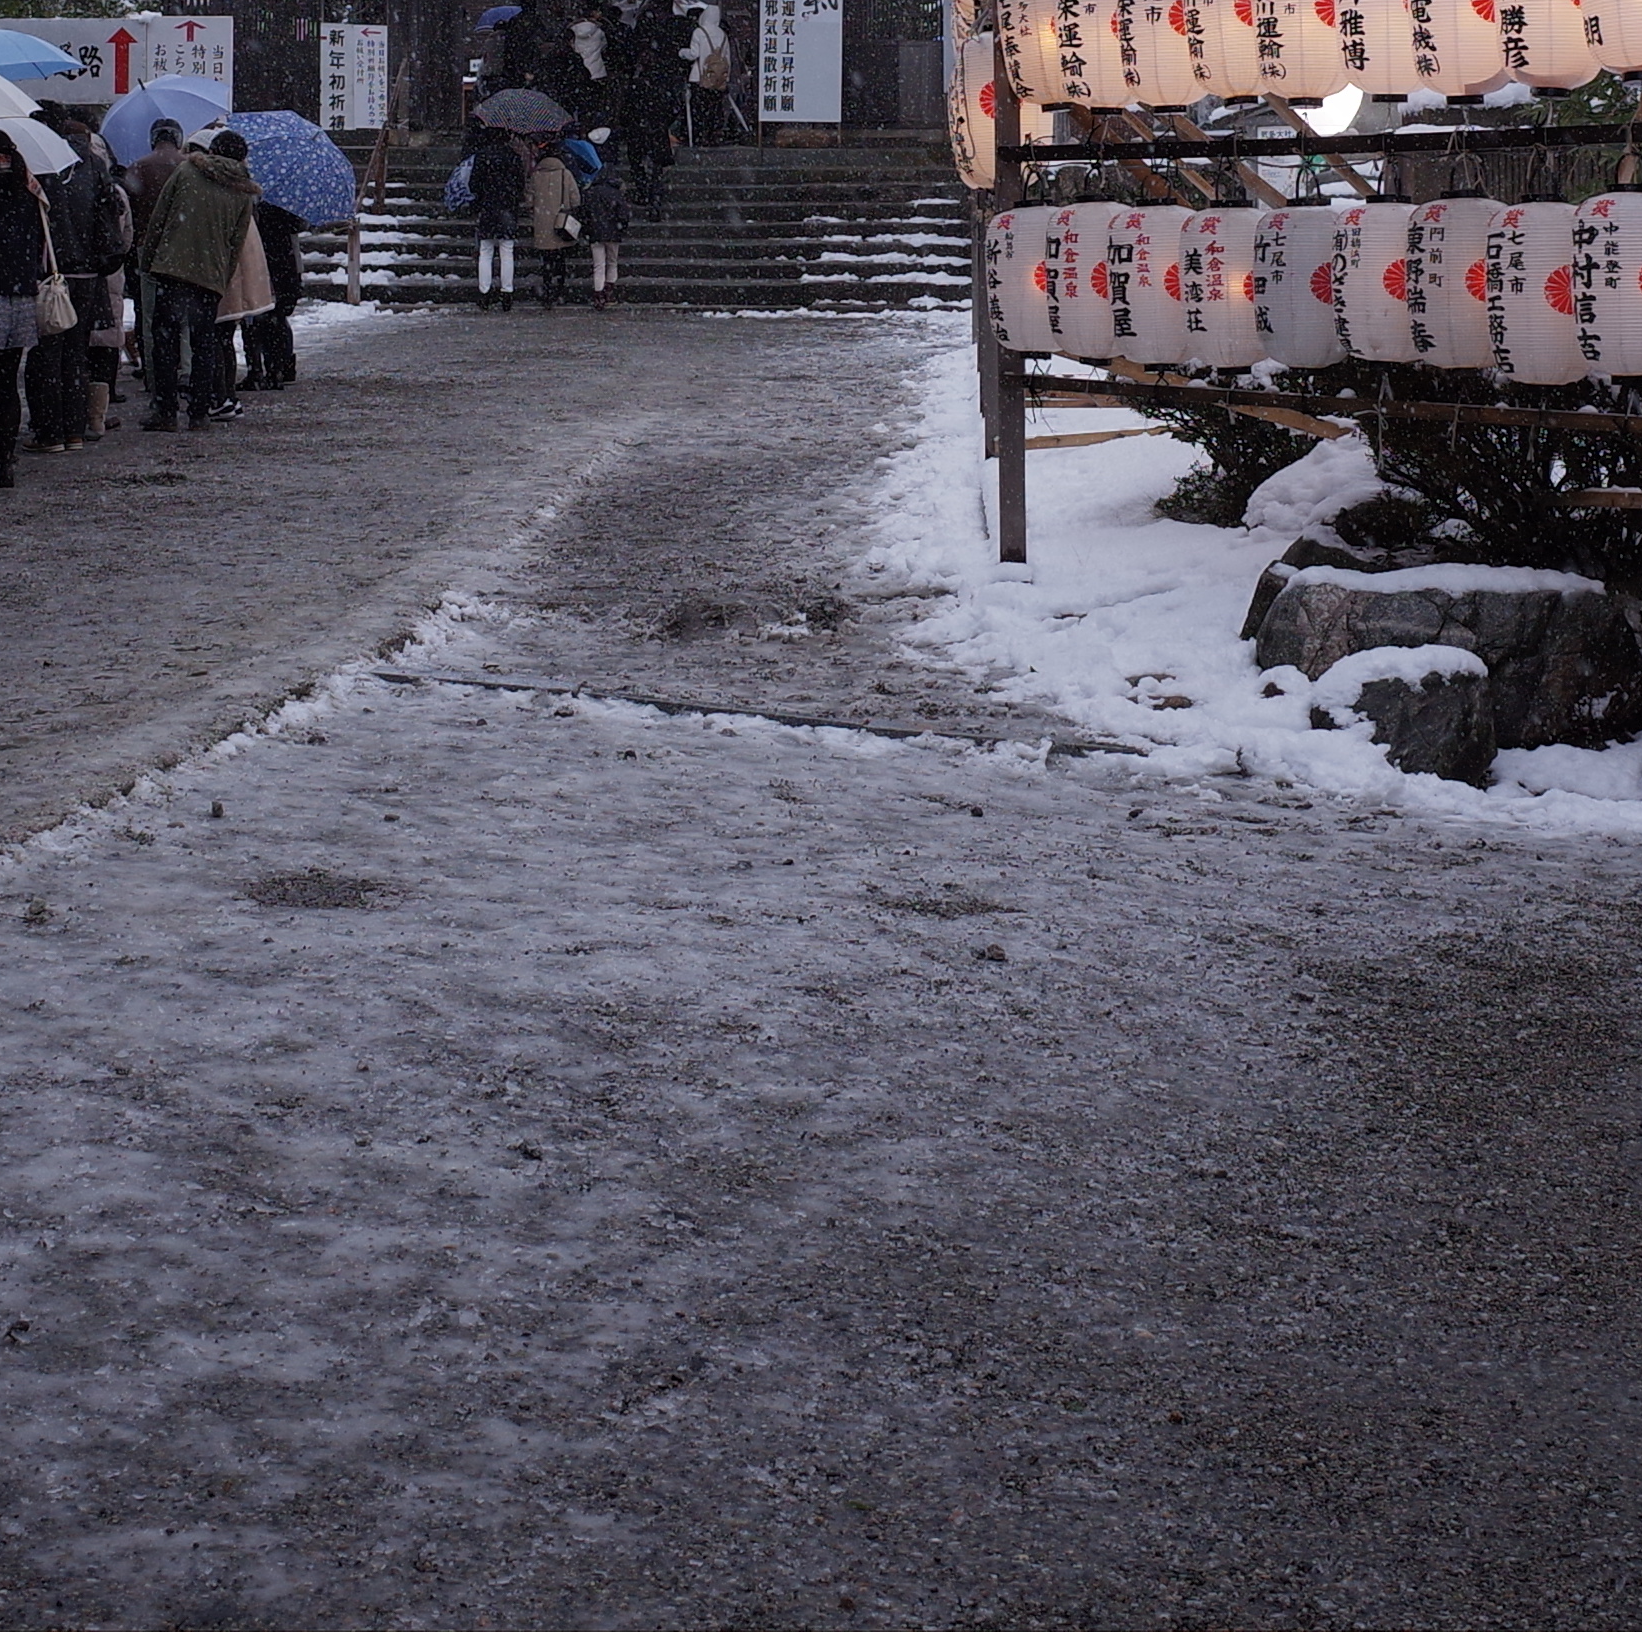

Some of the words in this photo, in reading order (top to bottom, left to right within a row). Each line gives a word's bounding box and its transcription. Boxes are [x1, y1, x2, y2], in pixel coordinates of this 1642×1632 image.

[763, 0, 778, 112] 邪気退散祈願
[780, 0, 796, 112] 運気上昇祈願
[1061, 228, 1079, 299] 和倉温泉
[1108, 234, 1138, 338] 加賀屋
[1135, 233, 1152, 288] 和倉温泉
[1204, 240, 1225, 302] 和倉温泉
[1270, 230, 1287, 285] 七尾市
[1428, 226, 1446, 289] 門前町
[1506, 229, 1527, 295] 七尾市
[1601, 221, 1623, 290] 中能登町
[1183, 248, 1208, 334] 美湾荘
